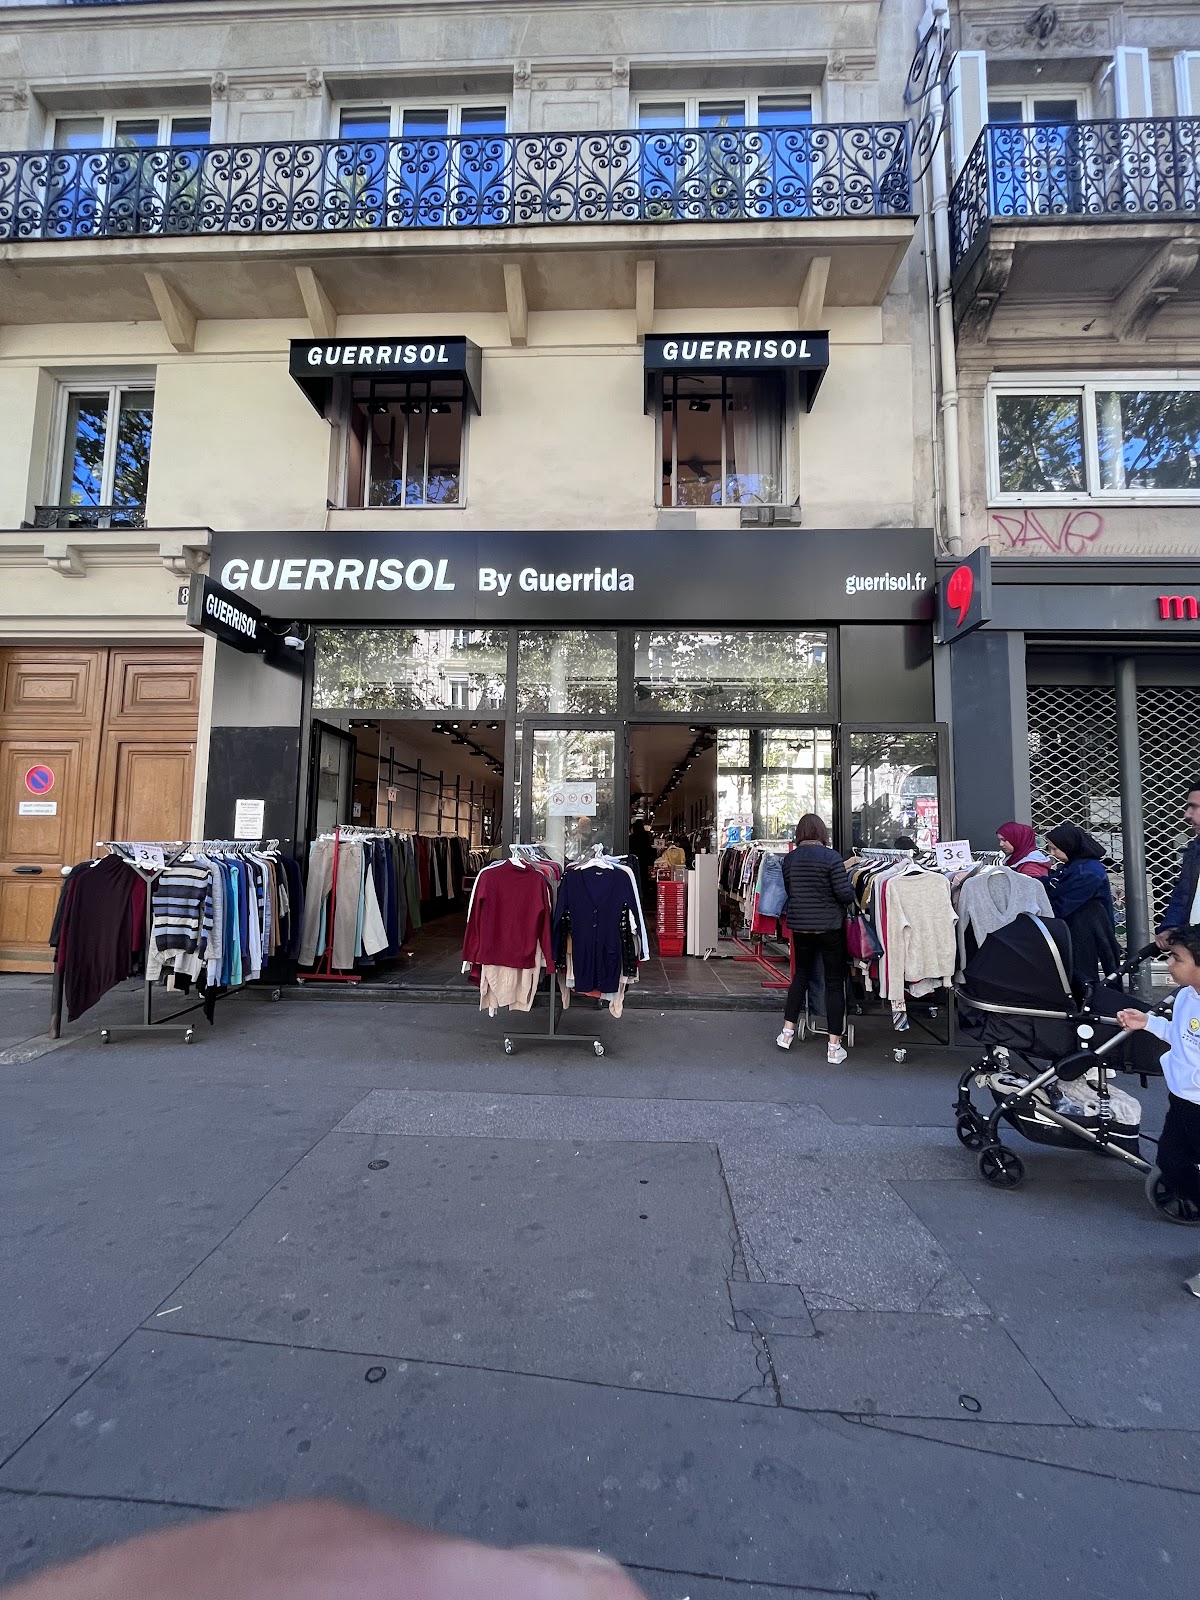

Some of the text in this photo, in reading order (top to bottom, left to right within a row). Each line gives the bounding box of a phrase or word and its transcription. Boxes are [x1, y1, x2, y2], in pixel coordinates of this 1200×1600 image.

[307, 344, 449, 366] GUERRISOL
[663, 339, 812, 361] GUERRISOL
[220, 558, 635, 597] GUERRISOL By Guerrida
[845, 572, 927, 595] guerrisol.fr
[206, 593, 257, 640] GUERRISOL
[1158, 595, 1200, 620] m
